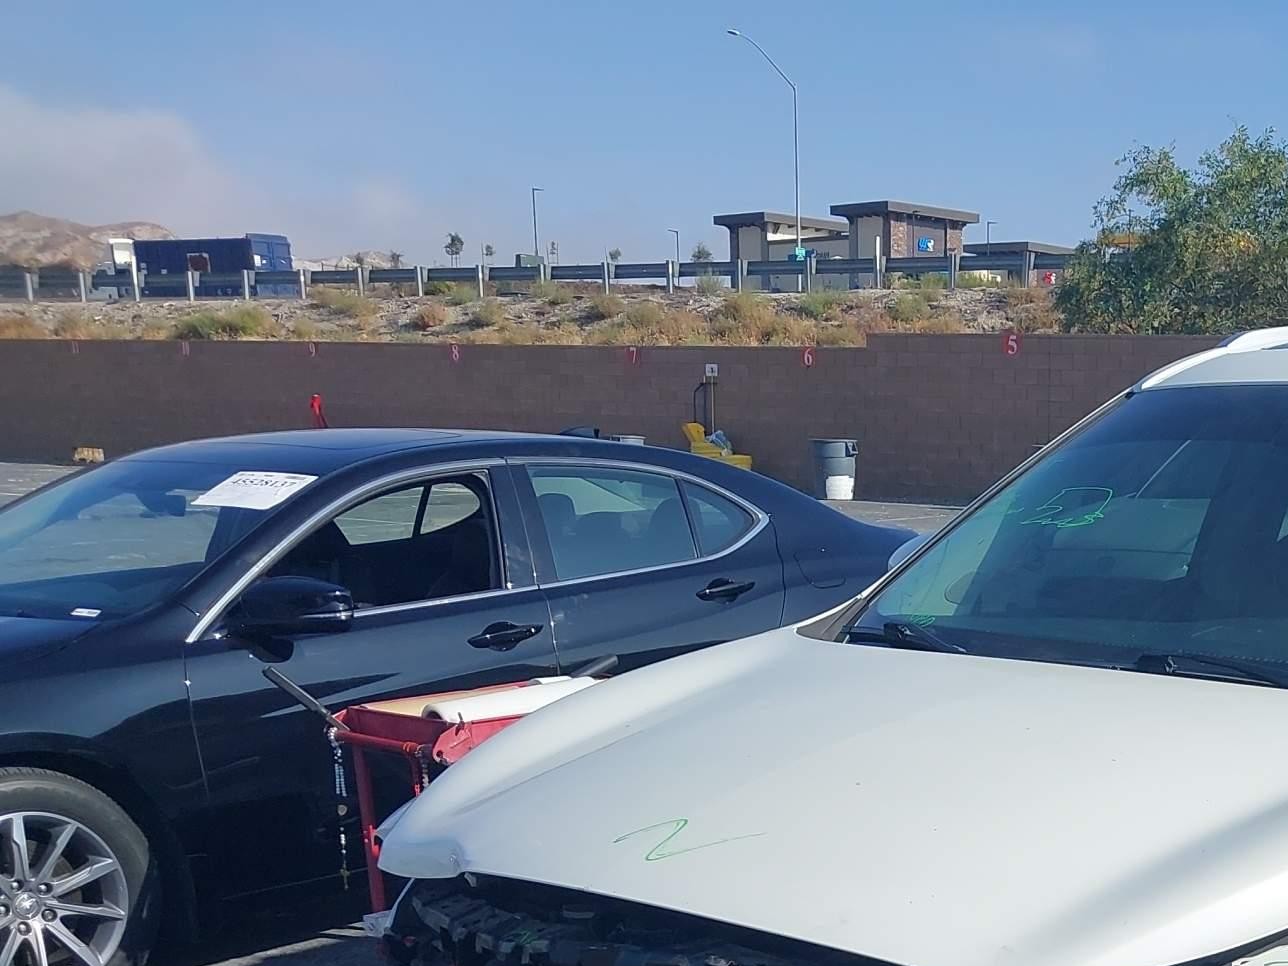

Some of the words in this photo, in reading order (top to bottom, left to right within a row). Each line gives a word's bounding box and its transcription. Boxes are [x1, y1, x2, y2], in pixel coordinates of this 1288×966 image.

[308, 342, 316, 357] 9
[452, 344, 460, 361] 8
[1007, 335, 1018, 355] 5
[629, 346, 637, 363] 7
[804, 348, 813, 366] 6
